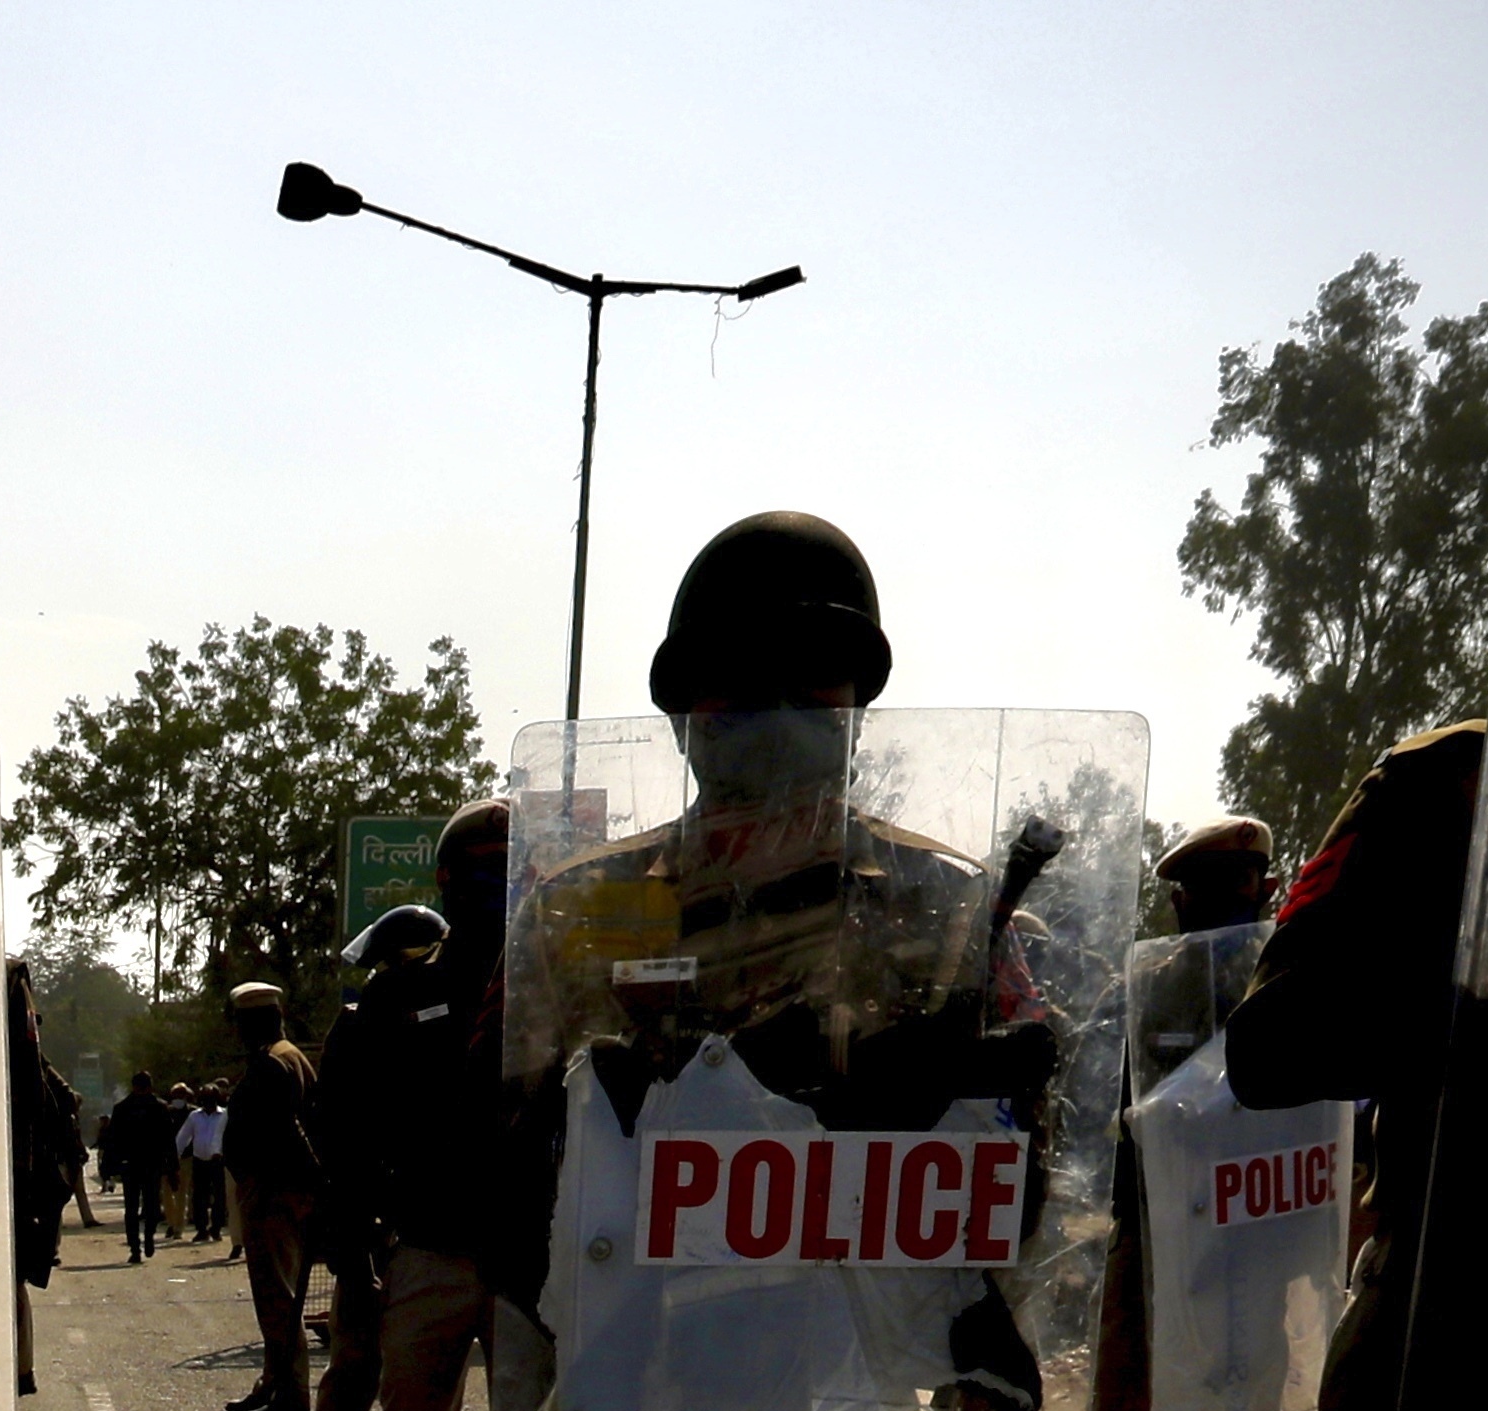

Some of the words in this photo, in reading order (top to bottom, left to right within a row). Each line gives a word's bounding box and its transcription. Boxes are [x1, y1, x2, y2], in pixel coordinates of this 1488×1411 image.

[362, 834, 433, 865] दिल्ली
[647, 1140, 1017, 1262] POLICE
[1214, 1143, 1337, 1225] POLICE
